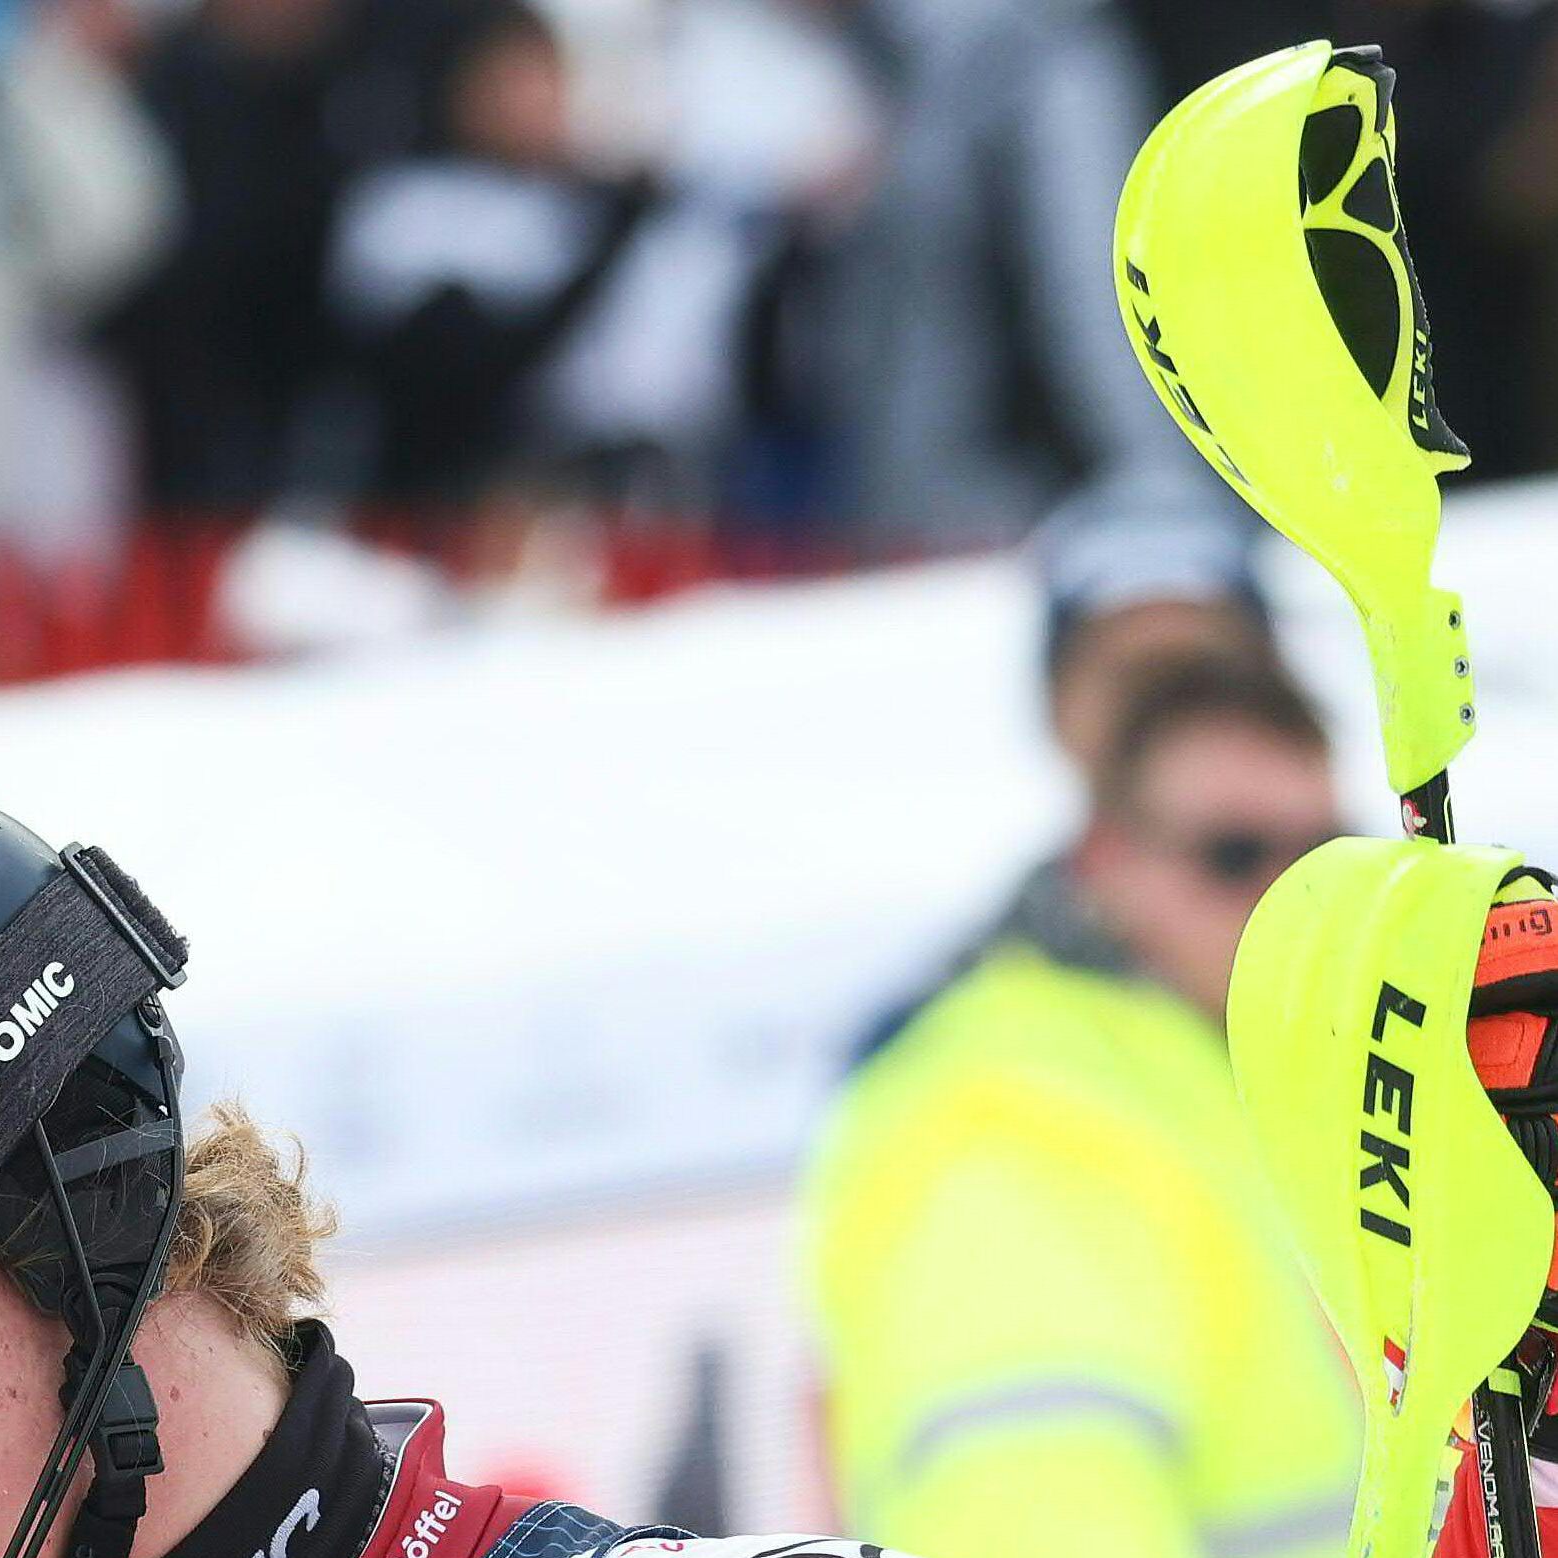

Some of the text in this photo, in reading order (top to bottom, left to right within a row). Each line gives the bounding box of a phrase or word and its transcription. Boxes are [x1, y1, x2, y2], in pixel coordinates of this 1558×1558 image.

[1412, 329, 1429, 430] LEKI
[1360, 980, 1427, 1248] LEKI
[1475, 1424, 1498, 1517] VENOM
